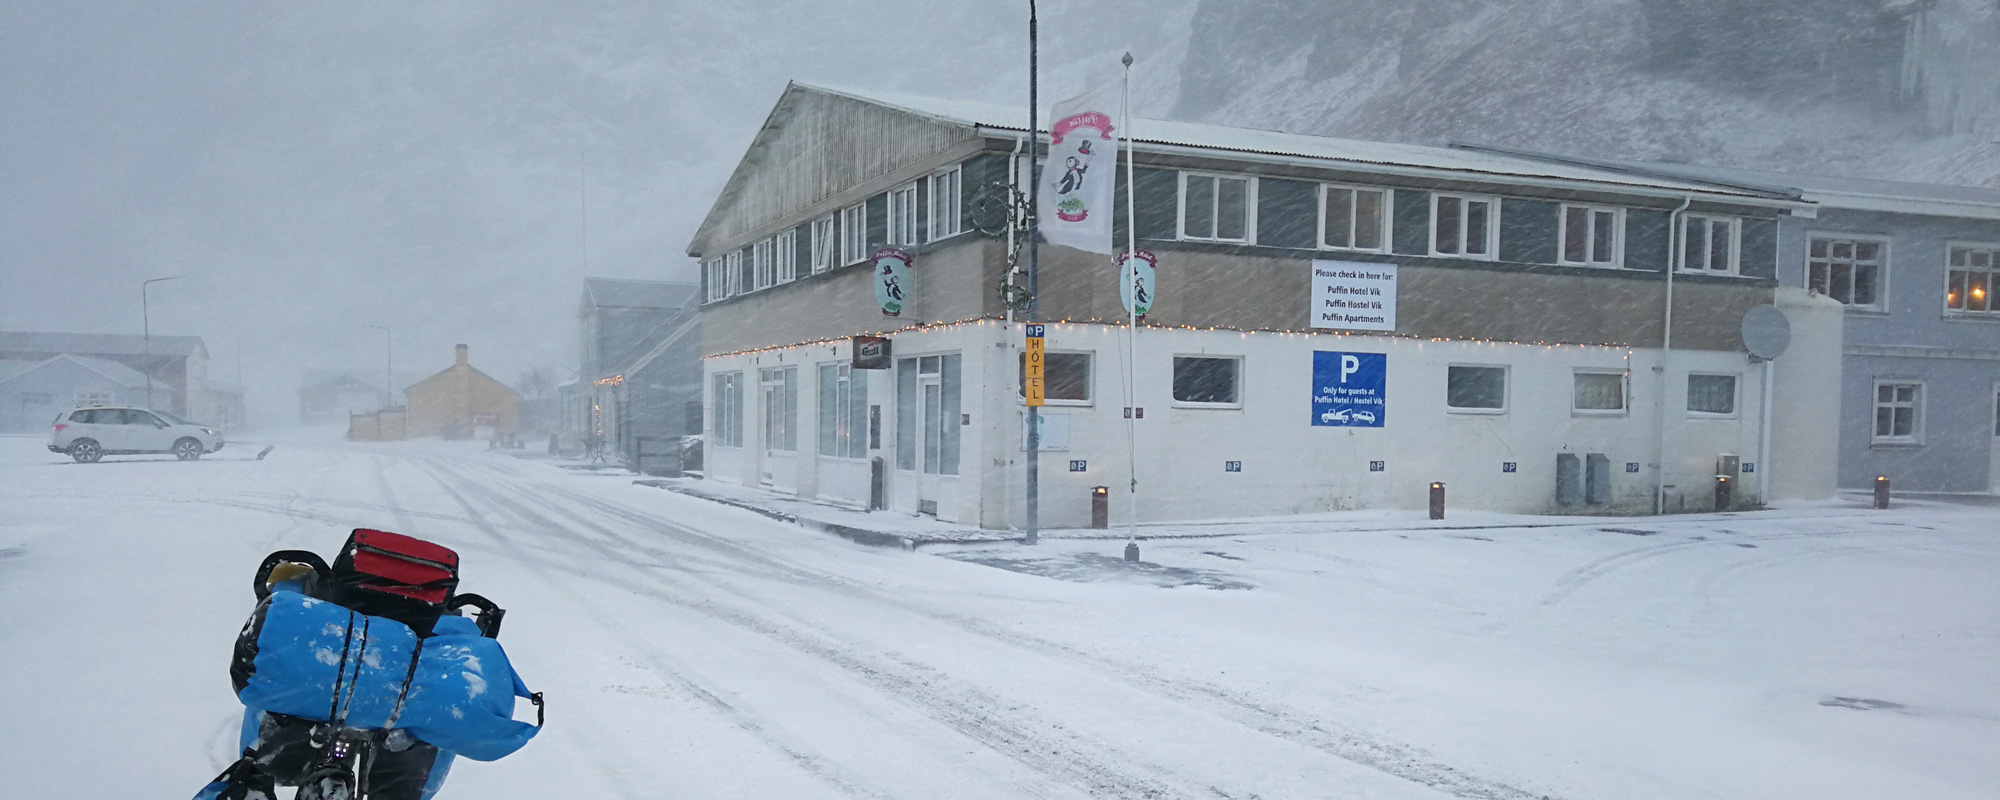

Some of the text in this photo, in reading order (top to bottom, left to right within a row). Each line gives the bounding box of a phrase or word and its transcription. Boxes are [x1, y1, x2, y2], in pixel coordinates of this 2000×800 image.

[1315, 269, 1394, 280] Please check in here for:
[1327, 286, 1348, 294] Puffin
[1350, 286, 1368, 295] Hotel
[1325, 300, 1346, 308] Puffin
[1348, 301, 1369, 309] Hostel
[1322, 313, 1385, 324] Puffin Apartments
[1035, 325, 1043, 336] P
[1341, 355, 1359, 383] P
[1323, 387, 1337, 395] Only
[1348, 388, 1367, 396] guests
